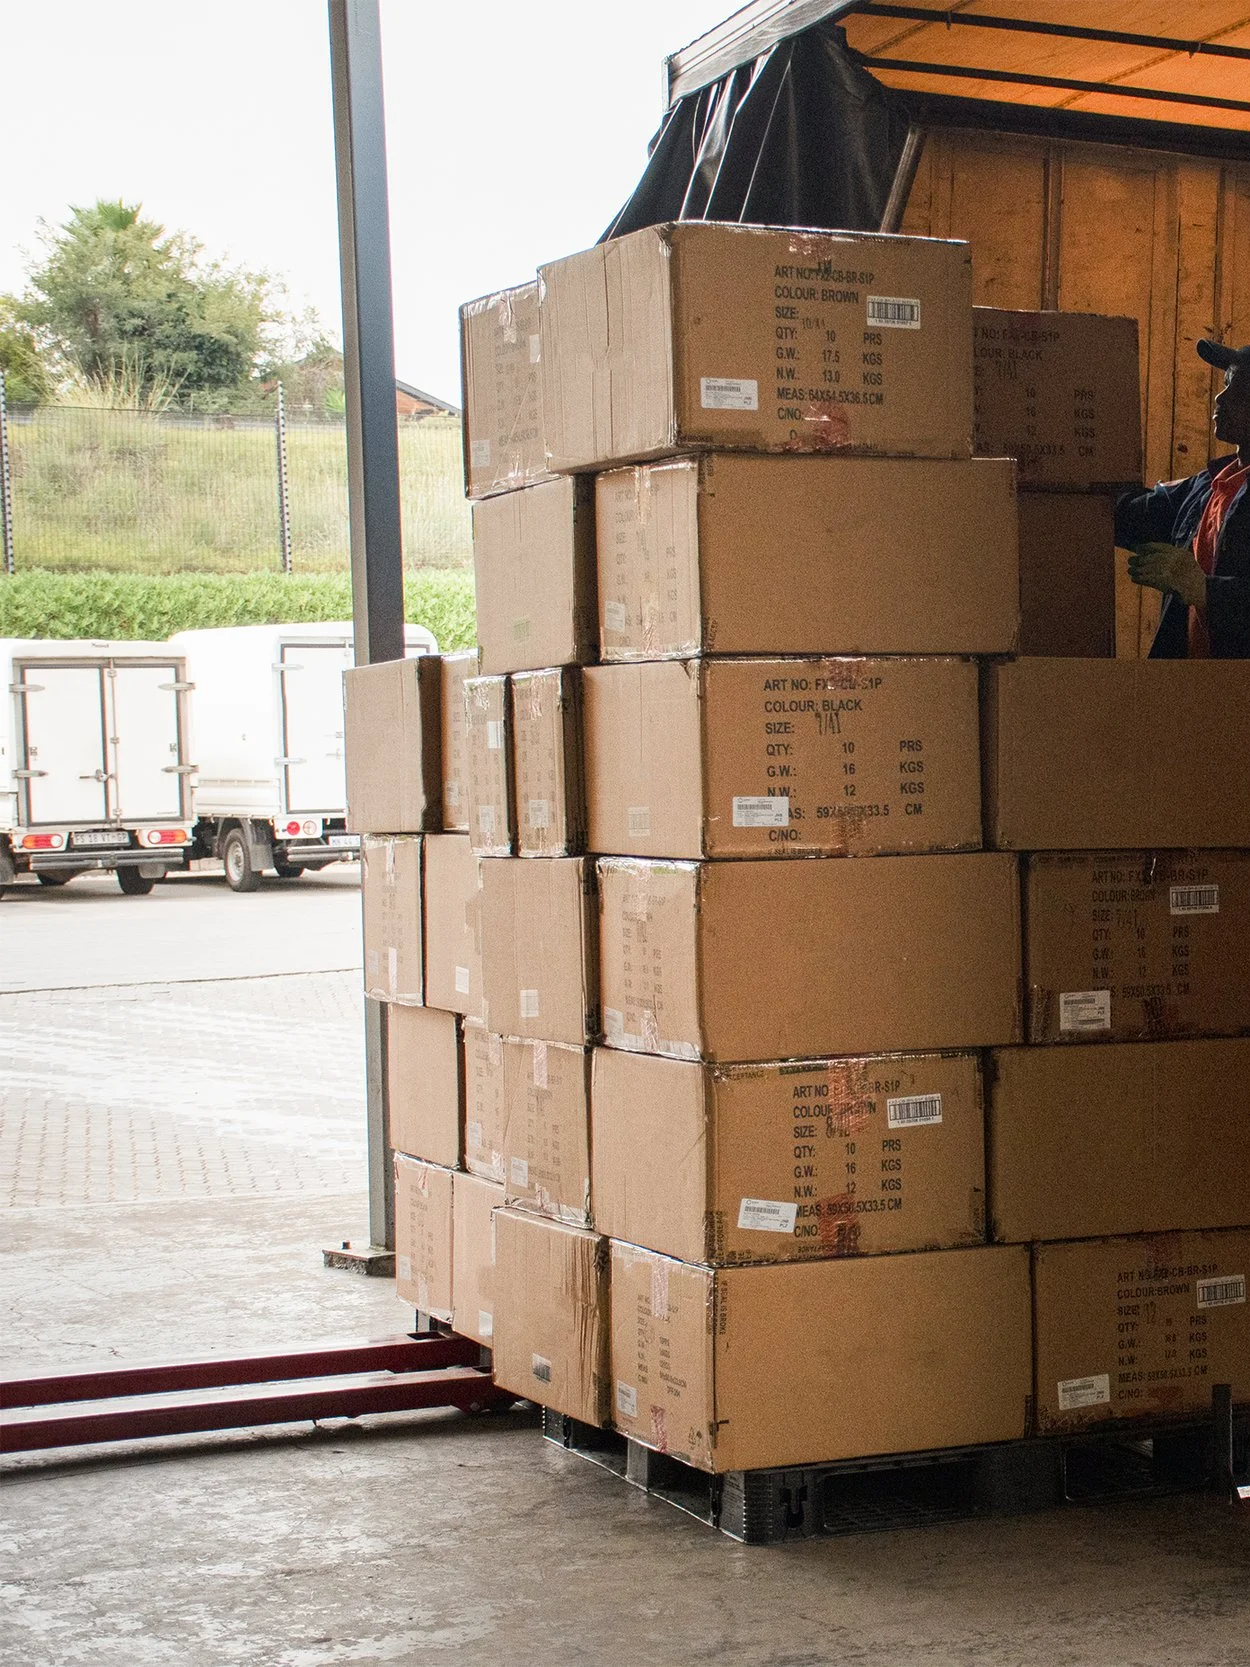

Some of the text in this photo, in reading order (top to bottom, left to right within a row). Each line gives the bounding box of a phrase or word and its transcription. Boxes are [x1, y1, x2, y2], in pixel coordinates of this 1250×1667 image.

[774, 265, 793, 280] ART
[774, 285, 819, 301] COLOUR:
[821, 289, 860, 305] BROWN
[774, 306, 799, 320] SIZE:
[775, 326, 882, 346] QTY: 10 PRS
[821, 349, 840, 363] 17.5
[862, 352, 883, 366] KGS
[821, 369, 840, 383] 13.0
[862, 372, 883, 386] KGS
[868, 393, 884, 405] CM
[764, 678, 788, 691] ART
[791, 678, 812, 691] NO:
[764, 699, 863, 713] COLOUR: BLACK
[765, 722, 795, 734] SIZE:
[766, 740, 923, 756] QTY: 10 PRS
[767, 761, 924, 778] G.W.: 16 KGS
[843, 785, 857, 797] 12
[900, 782, 925, 794] KGS
[904, 803, 923, 816] CM
[768, 829, 802, 842] C/NO:
[1172, 925, 1190, 938] PRS
[1172, 944, 1190, 957] KGS
[1171, 963, 1190, 976] KGS
[793, 1085, 812, 1099] ART
[793, 1125, 817, 1138] SIZE:
[794, 1138, 902, 1159] QTY: 10 PRS
[794, 1158, 902, 1178] G.W.: 16 KGS
[794, 1178, 902, 1198] N.W.: 12 KGS
[887, 1198, 902, 1211] CM
[1117, 1271, 1134, 1284] ART
[1189, 1315, 1208, 1327] PRS
[1188, 1331, 1208, 1343] KGS
[1189, 1347, 1208, 1360] KGS
